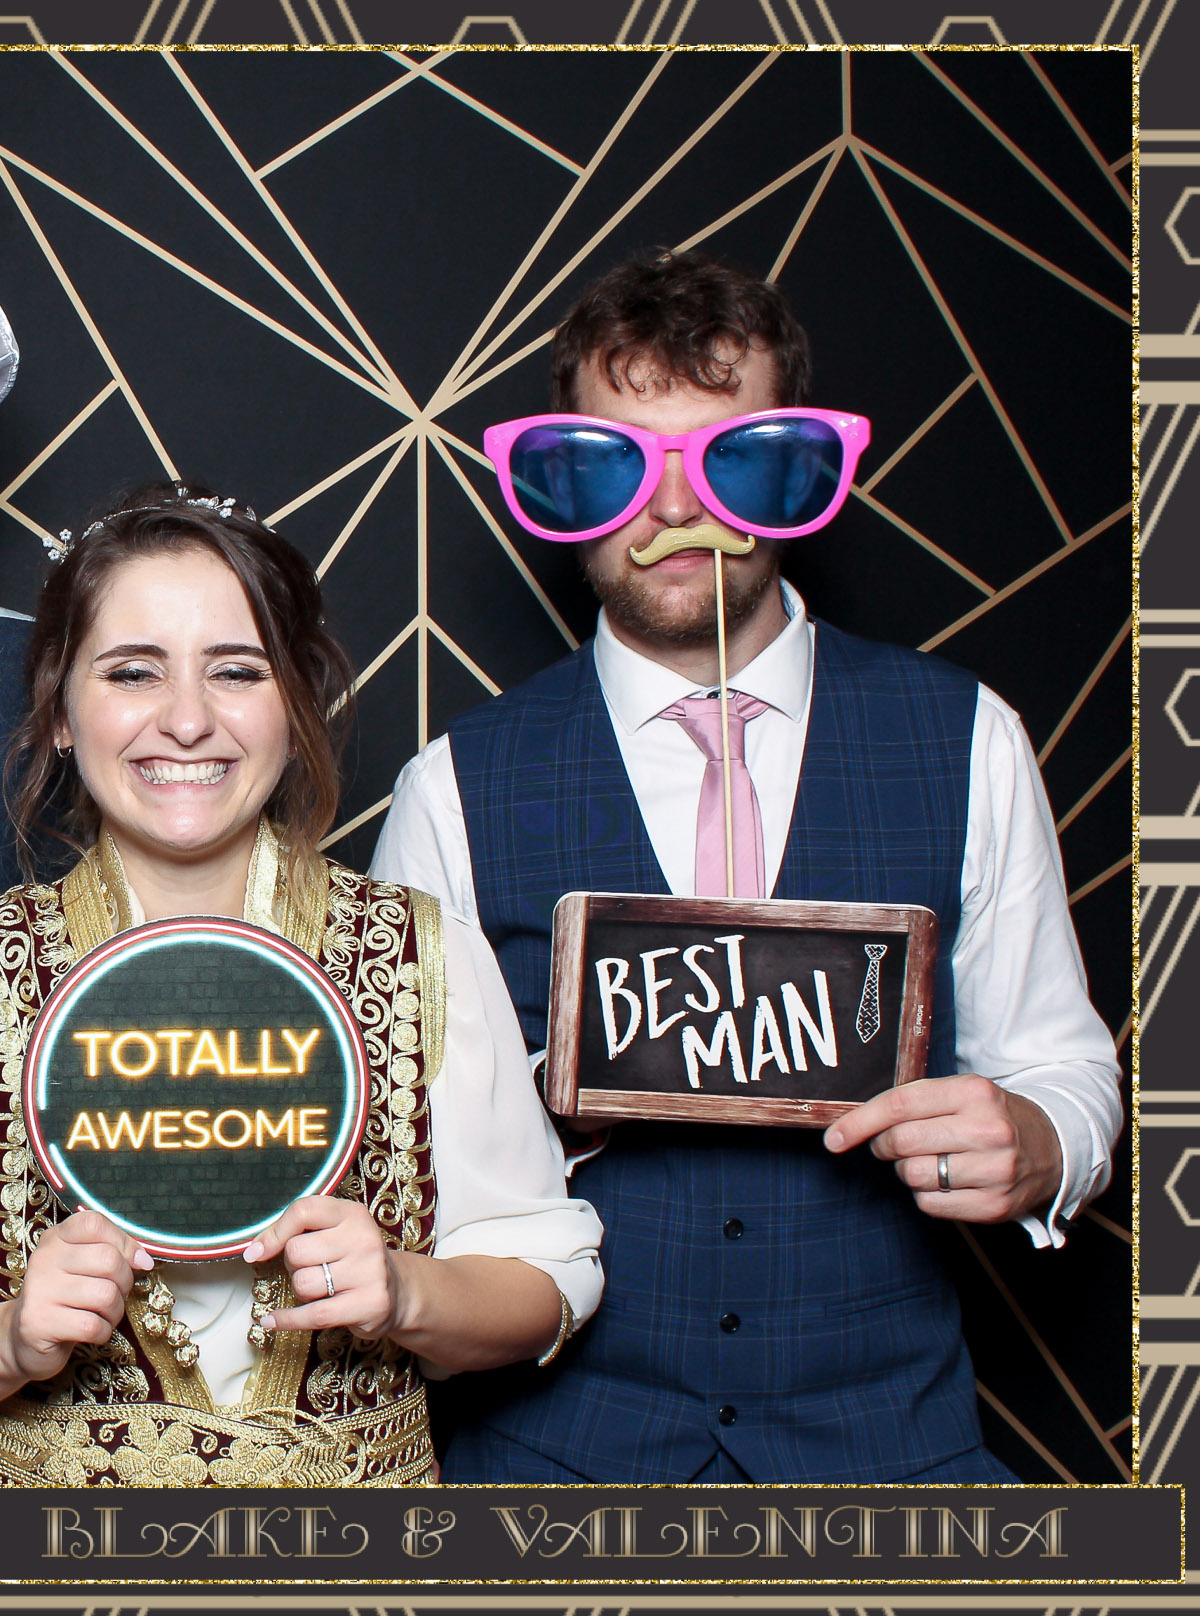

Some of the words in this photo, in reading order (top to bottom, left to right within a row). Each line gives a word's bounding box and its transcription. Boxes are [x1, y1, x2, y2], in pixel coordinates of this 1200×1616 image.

[595, 934, 745, 1060] BEST
[682, 969, 838, 1088] MAN
[73, 1028, 320, 1077] TOTALLY
[66, 1108, 329, 1150] AWESOME
